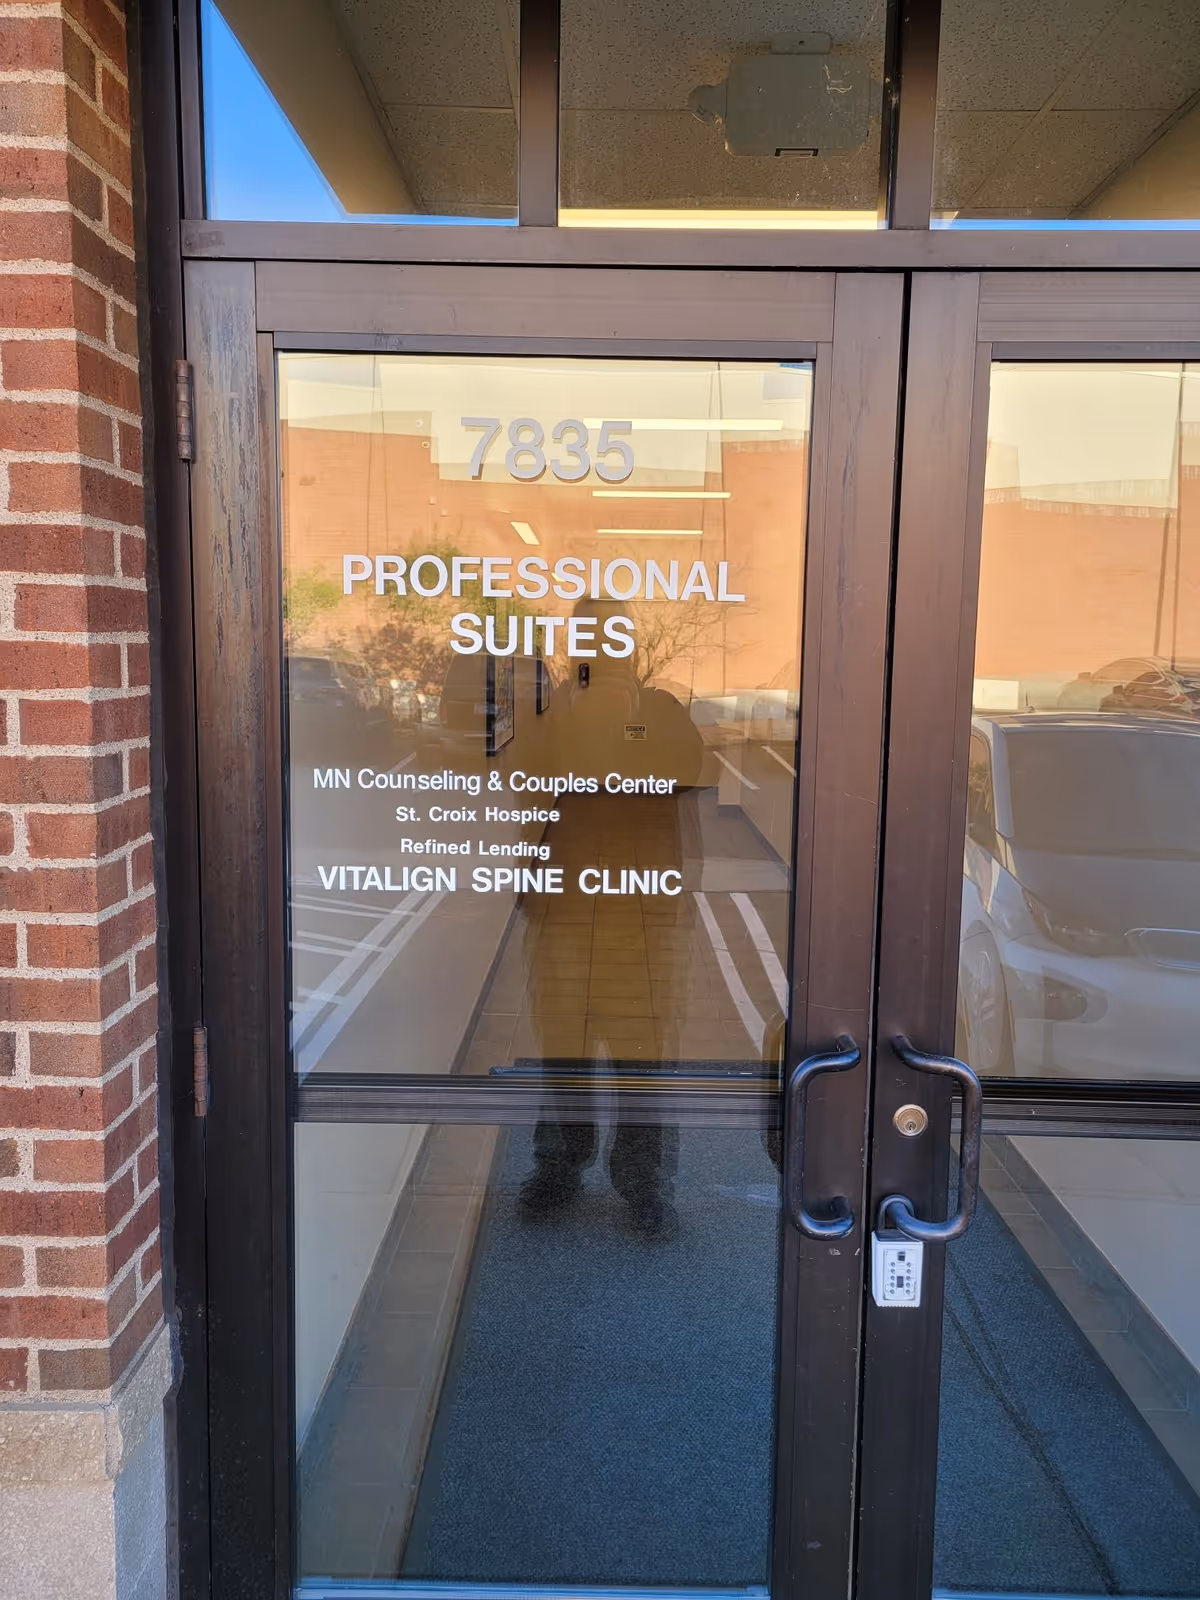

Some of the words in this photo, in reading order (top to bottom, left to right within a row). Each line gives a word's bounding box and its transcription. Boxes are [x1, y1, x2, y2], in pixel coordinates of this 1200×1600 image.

[460, 416, 635, 484] 7835
[342, 553, 746, 603] PROFESSIONAL
[448, 612, 636, 658] SUITES
[312, 768, 351, 789] MN
[357, 768, 481, 795] Counseling
[486, 770, 503, 793] &
[508, 770, 599, 798] Couples
[604, 772, 677, 795] Center
[395, 806, 421, 822] St.
[428, 806, 477, 823] Croix
[485, 807, 560, 825] Hospice
[400, 838, 471, 855] Refined
[478, 840, 551, 861] Lending
[317, 865, 457, 893] VITALIGN
[471, 866, 564, 894] SPINE
[578, 868, 683, 896] CLINIC
